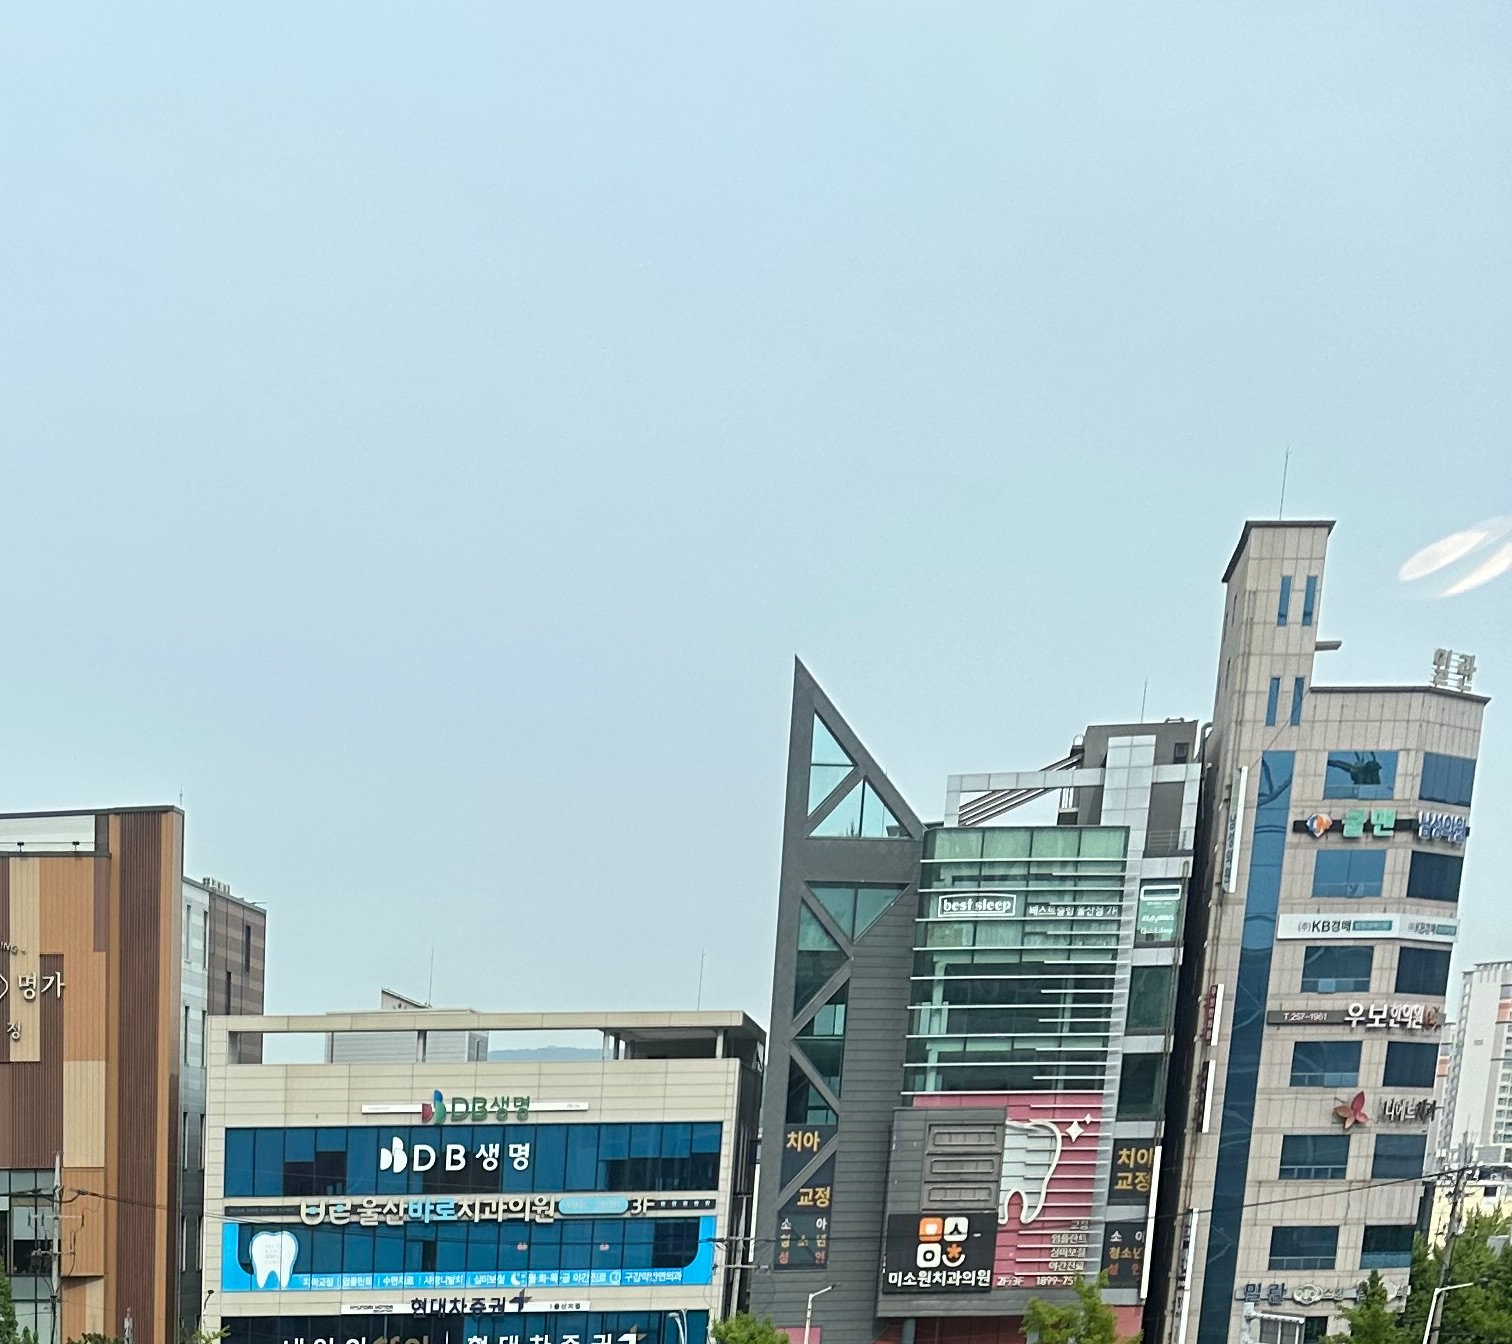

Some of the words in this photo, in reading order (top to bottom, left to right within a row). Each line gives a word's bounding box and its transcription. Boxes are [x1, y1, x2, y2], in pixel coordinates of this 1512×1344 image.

[943, 899, 971, 911] best
[975, 899, 1011, 913] sleep
[18, 971, 66, 1000] 명가
[1344, 1002, 1425, 1029] 우보한의원
[451, 1096, 531, 1122] DB생명
[786, 1131, 820, 1152] 치아
[413, 1143, 530, 1172] DB생명
[1114, 1171, 1151, 1192] 교정
[797, 1186, 831, 1208] 교정
[357, 1195, 555, 1226] 울산바로치과의원
[631, 1196, 655, 1215] 3F
[888, 1269, 991, 1288] 미소원치과의원
[410, 1297, 506, 1318] 현대차증권
